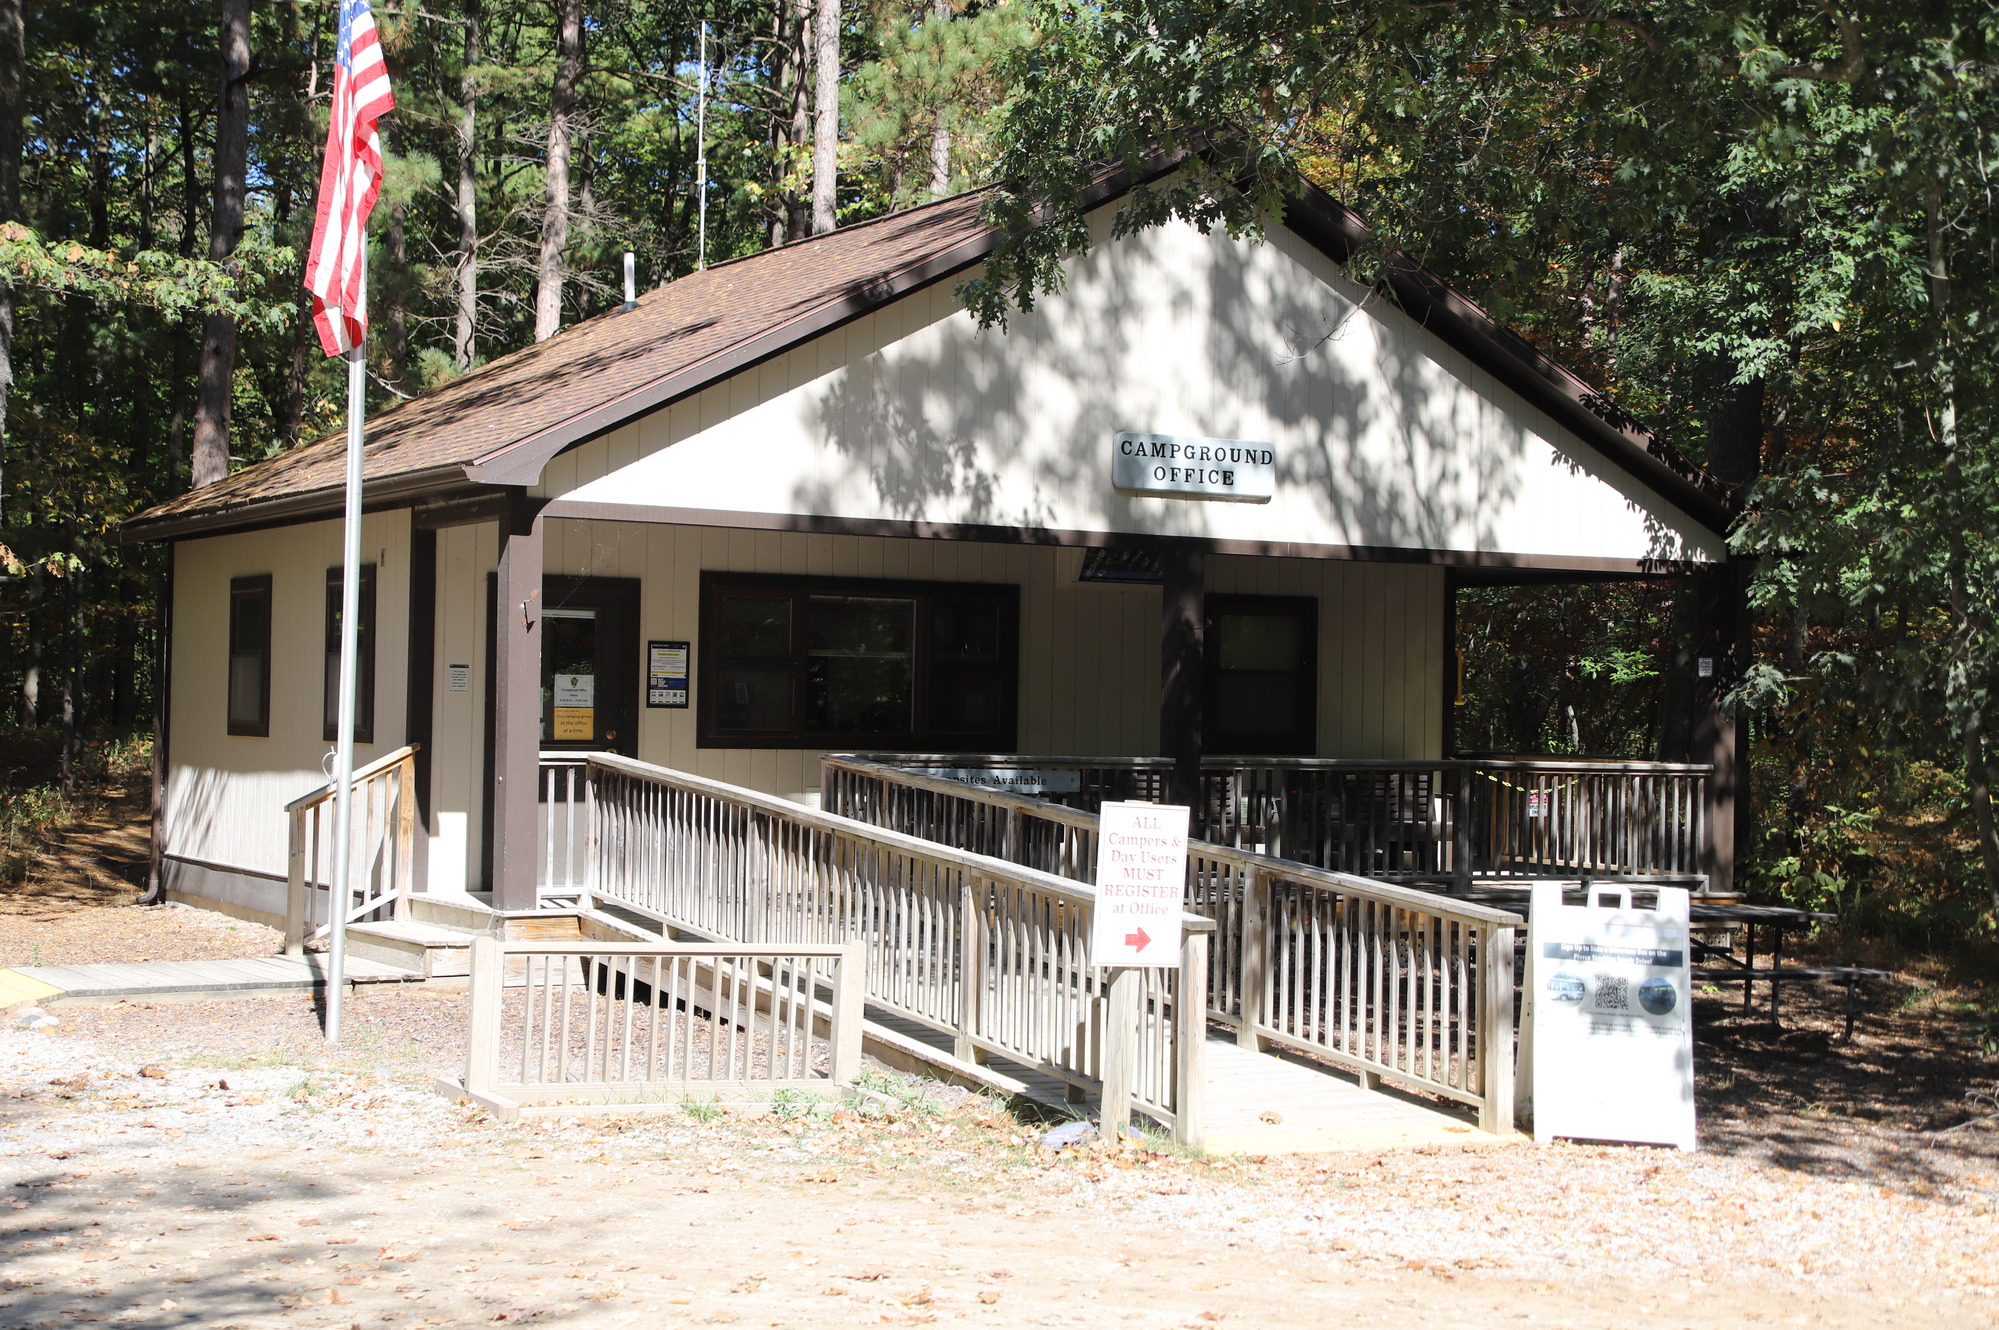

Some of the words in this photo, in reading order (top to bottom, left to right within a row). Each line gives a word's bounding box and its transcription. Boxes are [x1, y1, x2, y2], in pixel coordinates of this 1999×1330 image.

[1120, 440, 1273, 465] CAMPGROUND
[1154, 466, 1235, 486] OFFICE
[993, 775, 1047, 786] Available
[1132, 816, 1162, 830] ALL
[1108, 832, 1168, 849] Campers
[1171, 836, 1181, 848] &
[1111, 849, 1137, 865] Day
[1140, 851, 1177, 864] Users
[1123, 867, 1164, 881] MUST
[1104, 884, 1179, 899] REGISTER
[1112, 903, 1125, 914] at
[1129, 901, 1169, 915] Office
[1560, 943, 1574, 952] Sign
[1574, 943, 1582, 952] Up
[1656, 949, 1668, 957] the
